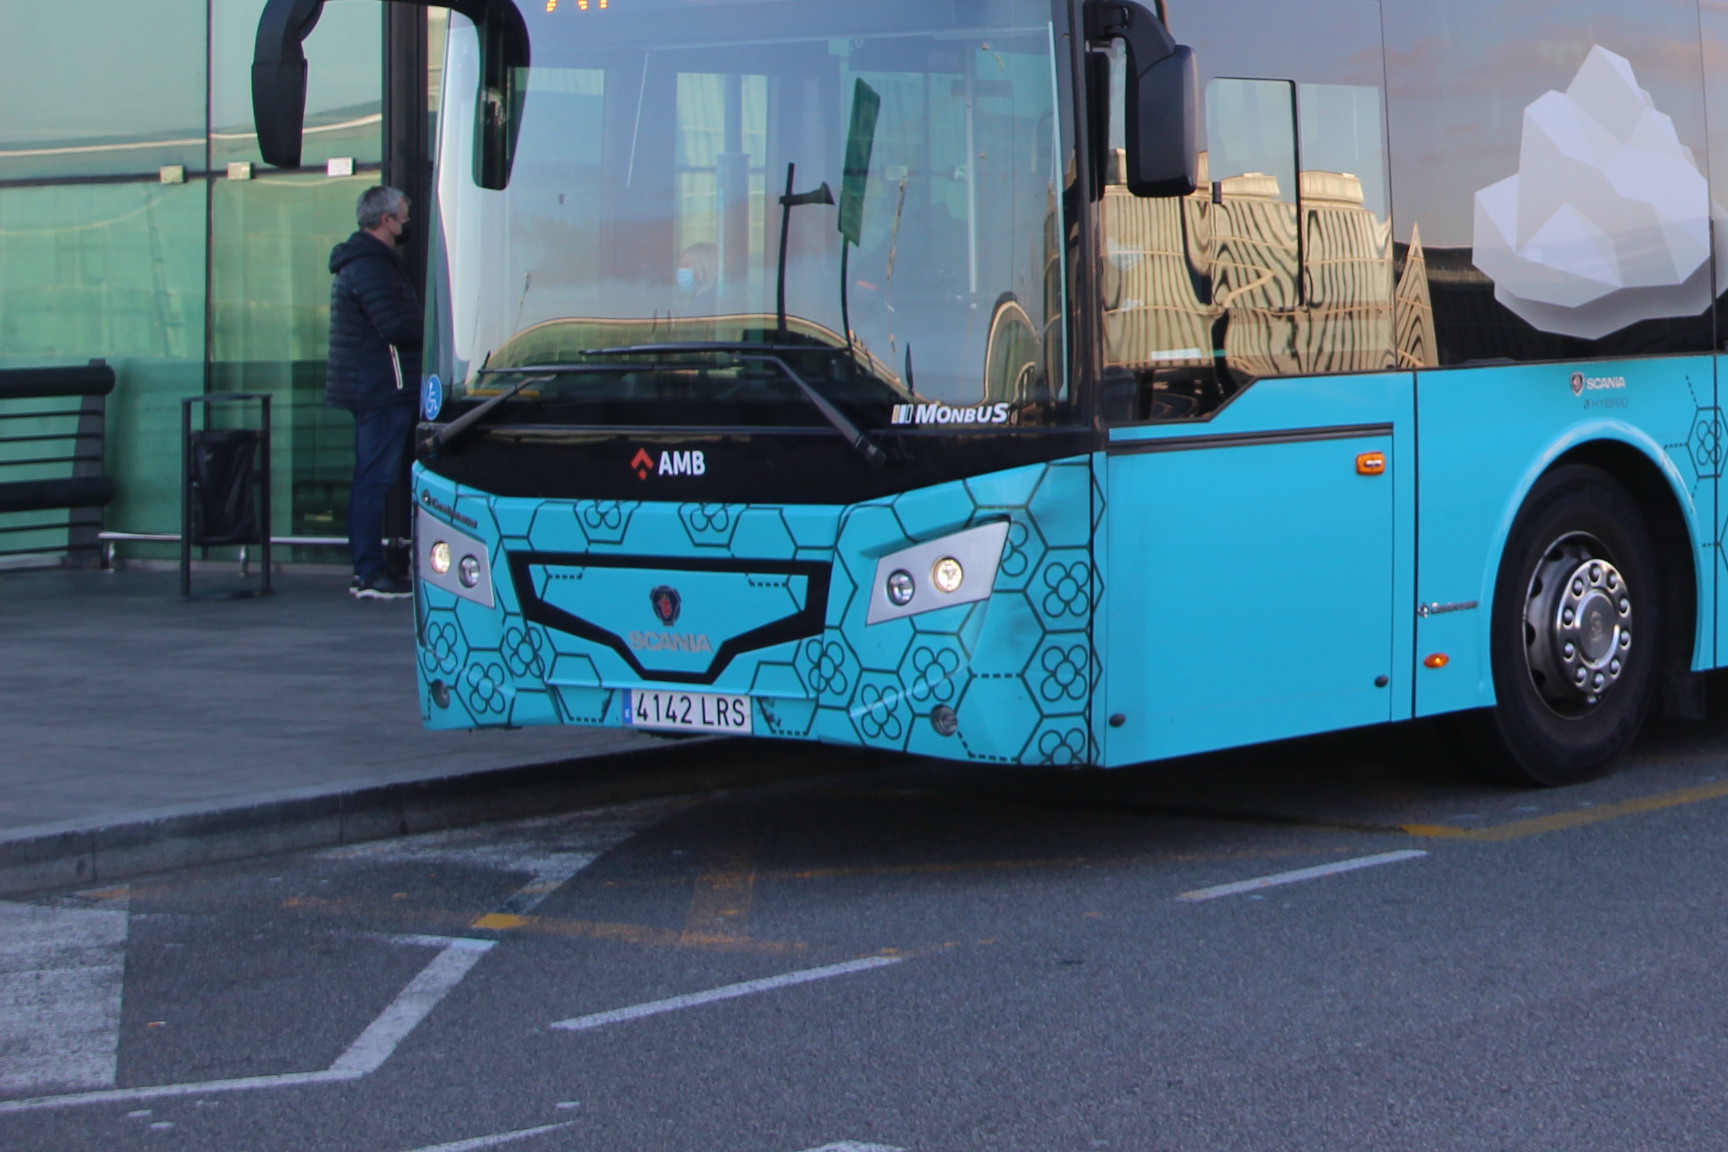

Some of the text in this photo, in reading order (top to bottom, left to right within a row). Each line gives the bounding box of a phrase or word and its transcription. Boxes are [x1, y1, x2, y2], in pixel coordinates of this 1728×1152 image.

[1586, 376, 1627, 390] SCANIA
[658, 450, 706, 476] AMB
[629, 630, 714, 653] SCANIA
[636, 692, 746, 727] 4142 LRS
